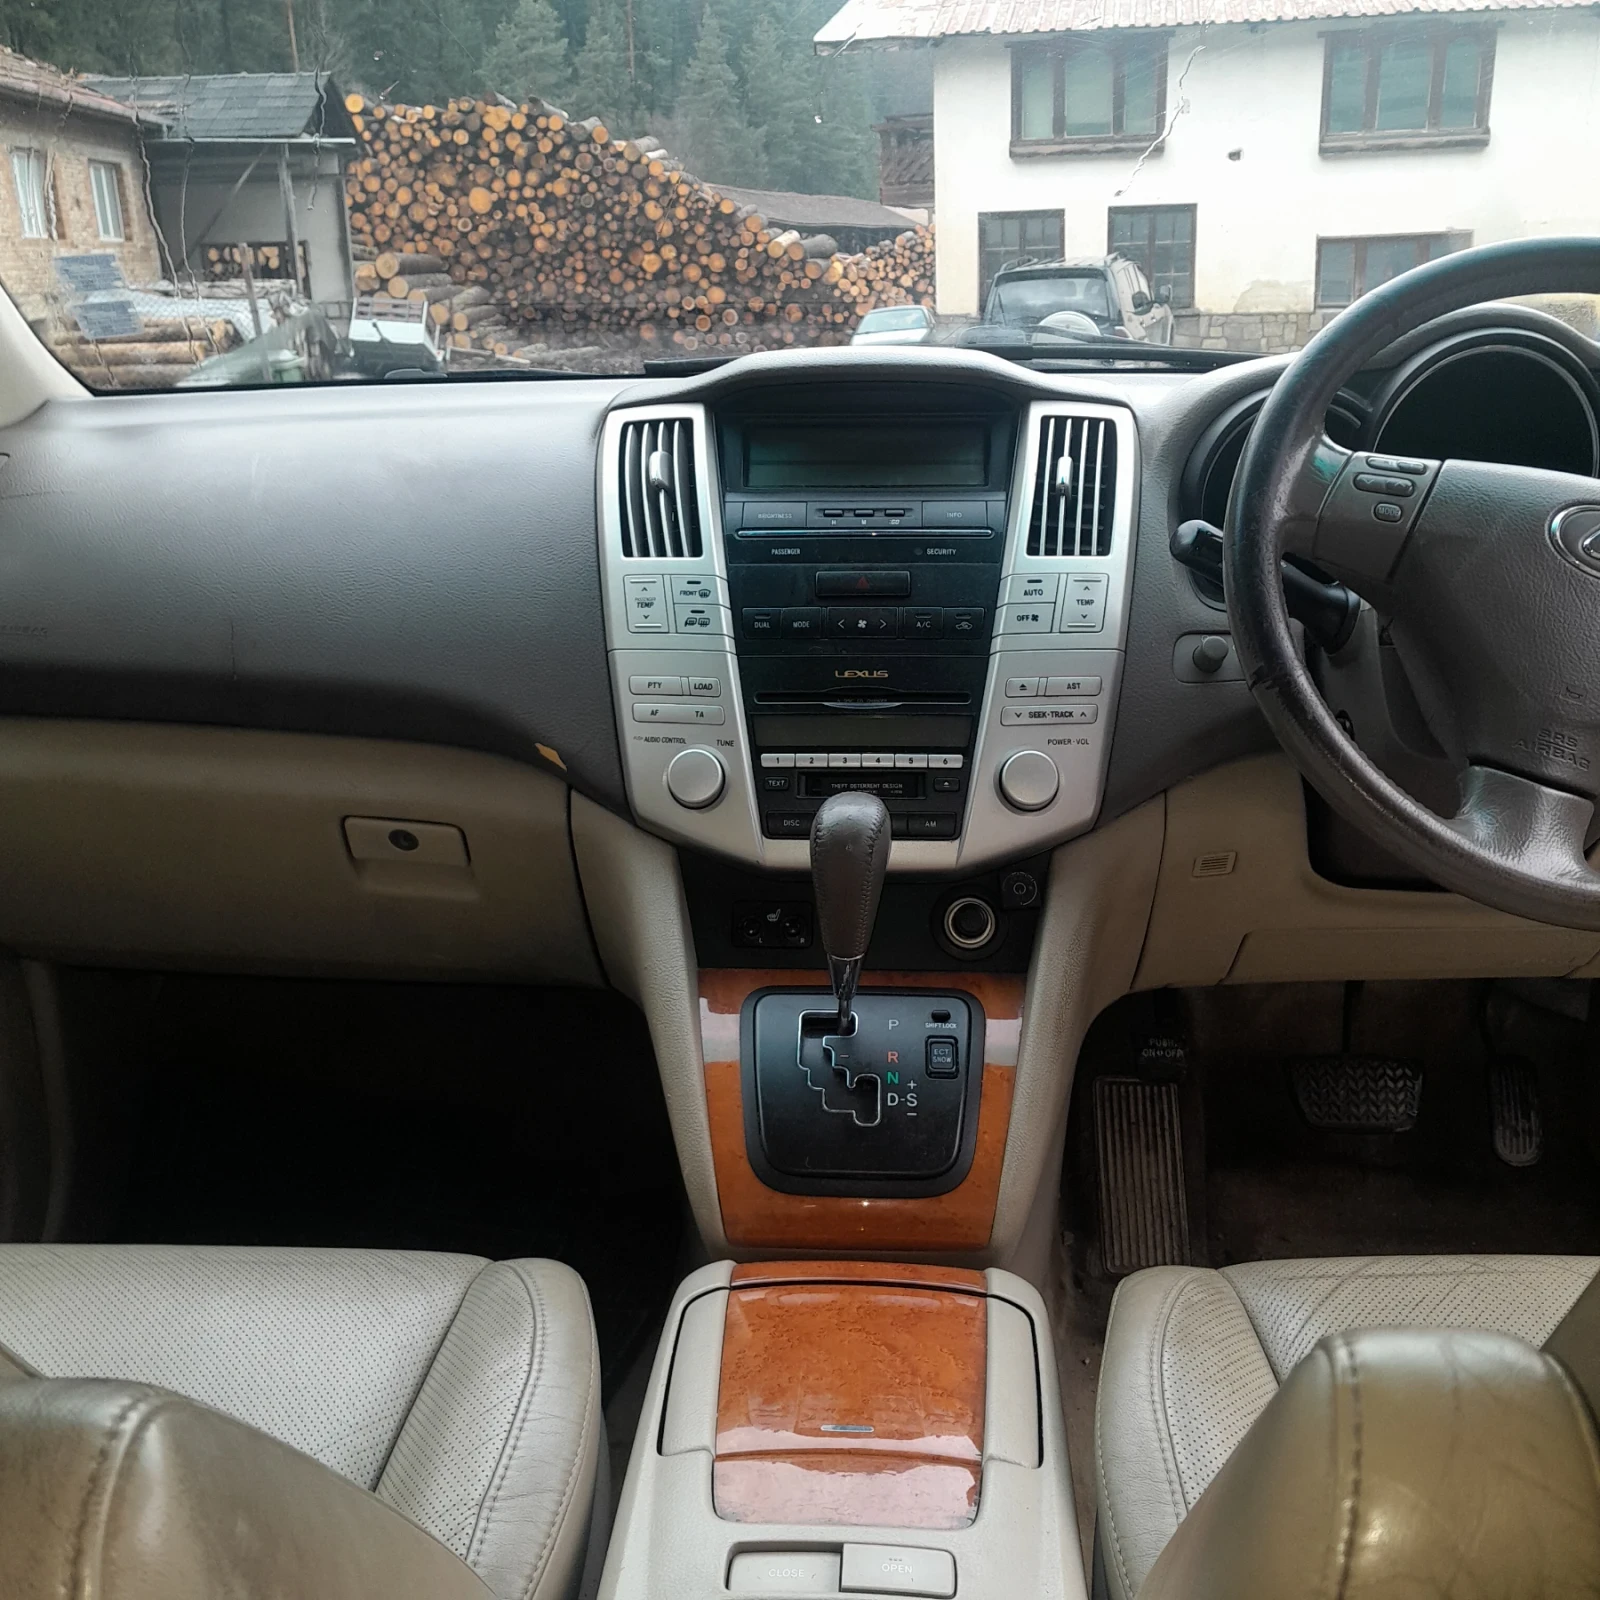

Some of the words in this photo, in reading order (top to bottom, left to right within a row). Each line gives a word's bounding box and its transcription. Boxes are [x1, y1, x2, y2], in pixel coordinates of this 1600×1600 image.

[1023, 589, 1044, 597] AUTO
[1016, 614, 1030, 622] OFF
[834, 670, 889, 678] LEXUS
[1066, 682, 1081, 690] AST
[716, 739, 735, 747] TUNE
[1047, 738, 1072, 746] POWER
[1075, 738, 1090, 746] VOL
[783, 819, 800, 827] DISC
[888, 1019, 899, 1031] P
[887, 1051, 899, 1063] R
[887, 1071, 899, 1085] N
[881, 1563, 913, 1574] OPEN
[768, 1568, 805, 1578] CLOSE
